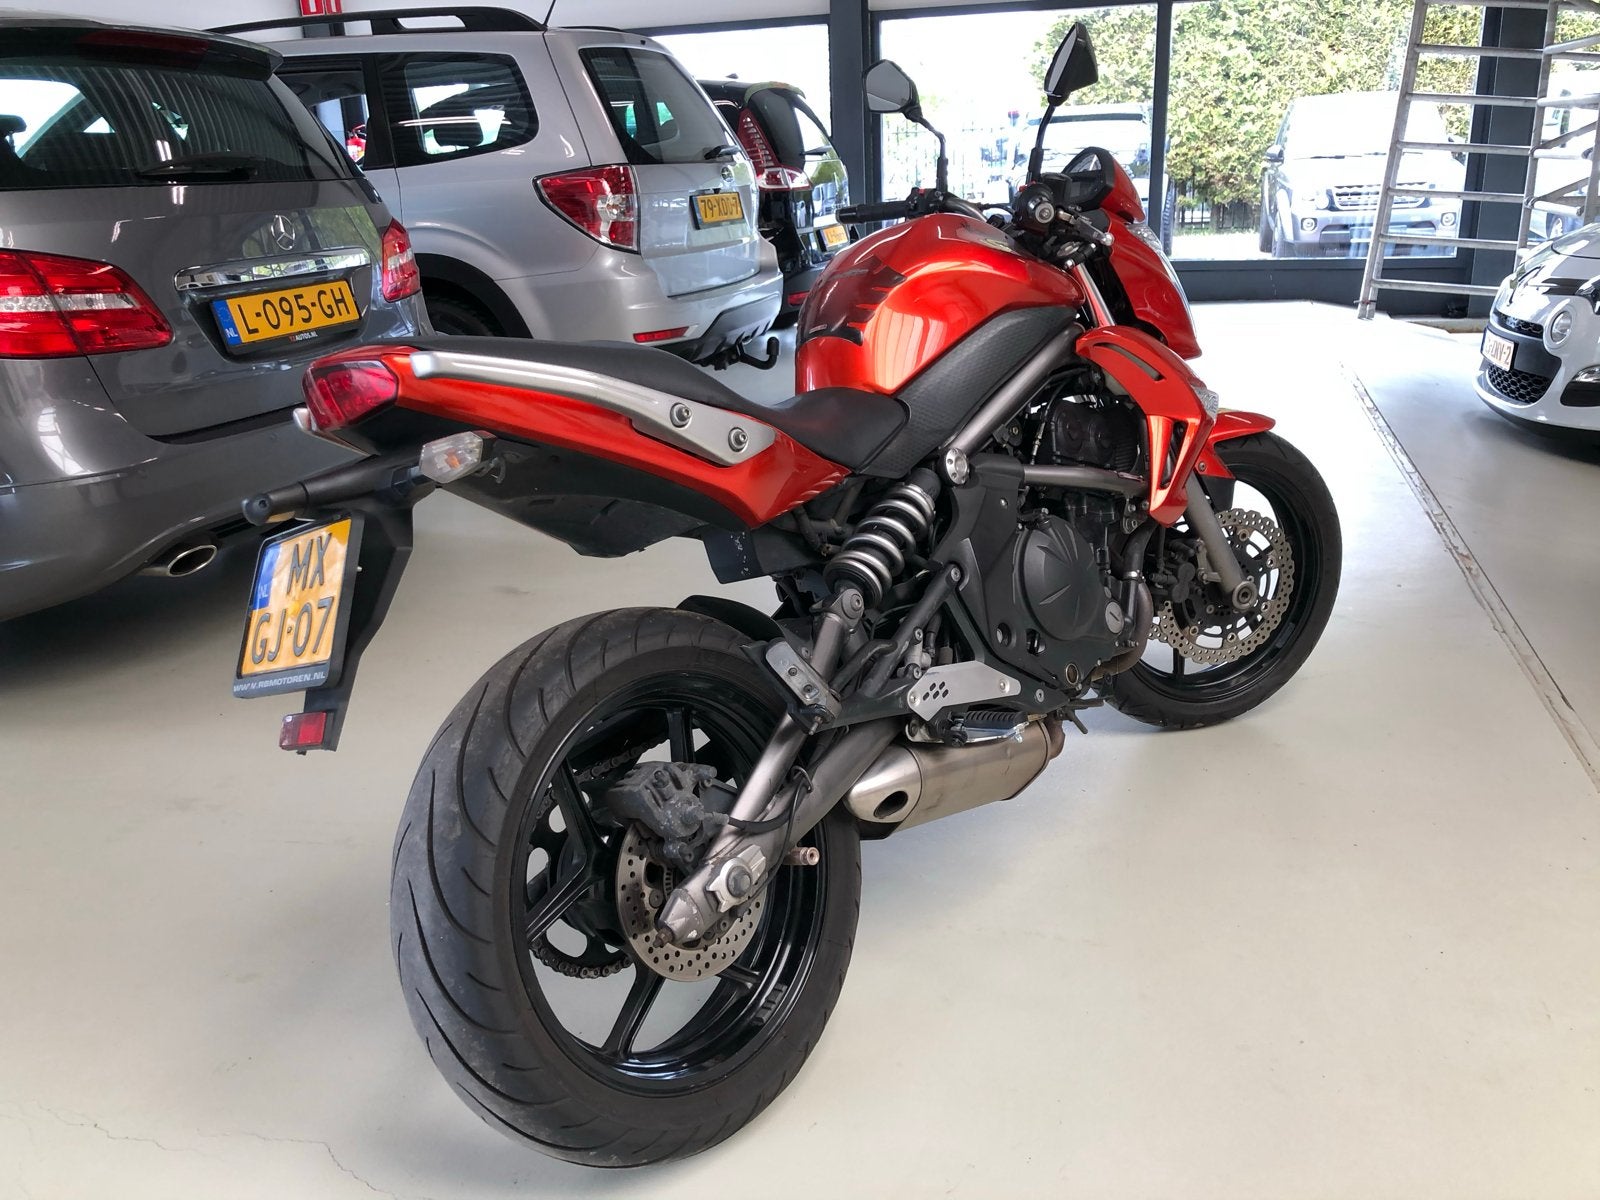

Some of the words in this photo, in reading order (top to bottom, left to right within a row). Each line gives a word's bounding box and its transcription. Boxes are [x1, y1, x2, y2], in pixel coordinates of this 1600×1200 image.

[225, 327, 239, 338] NL
[237, 287, 351, 334] L-095-GH
[286, 532, 332, 595] MX
[251, 596, 334, 664] GJ-07
